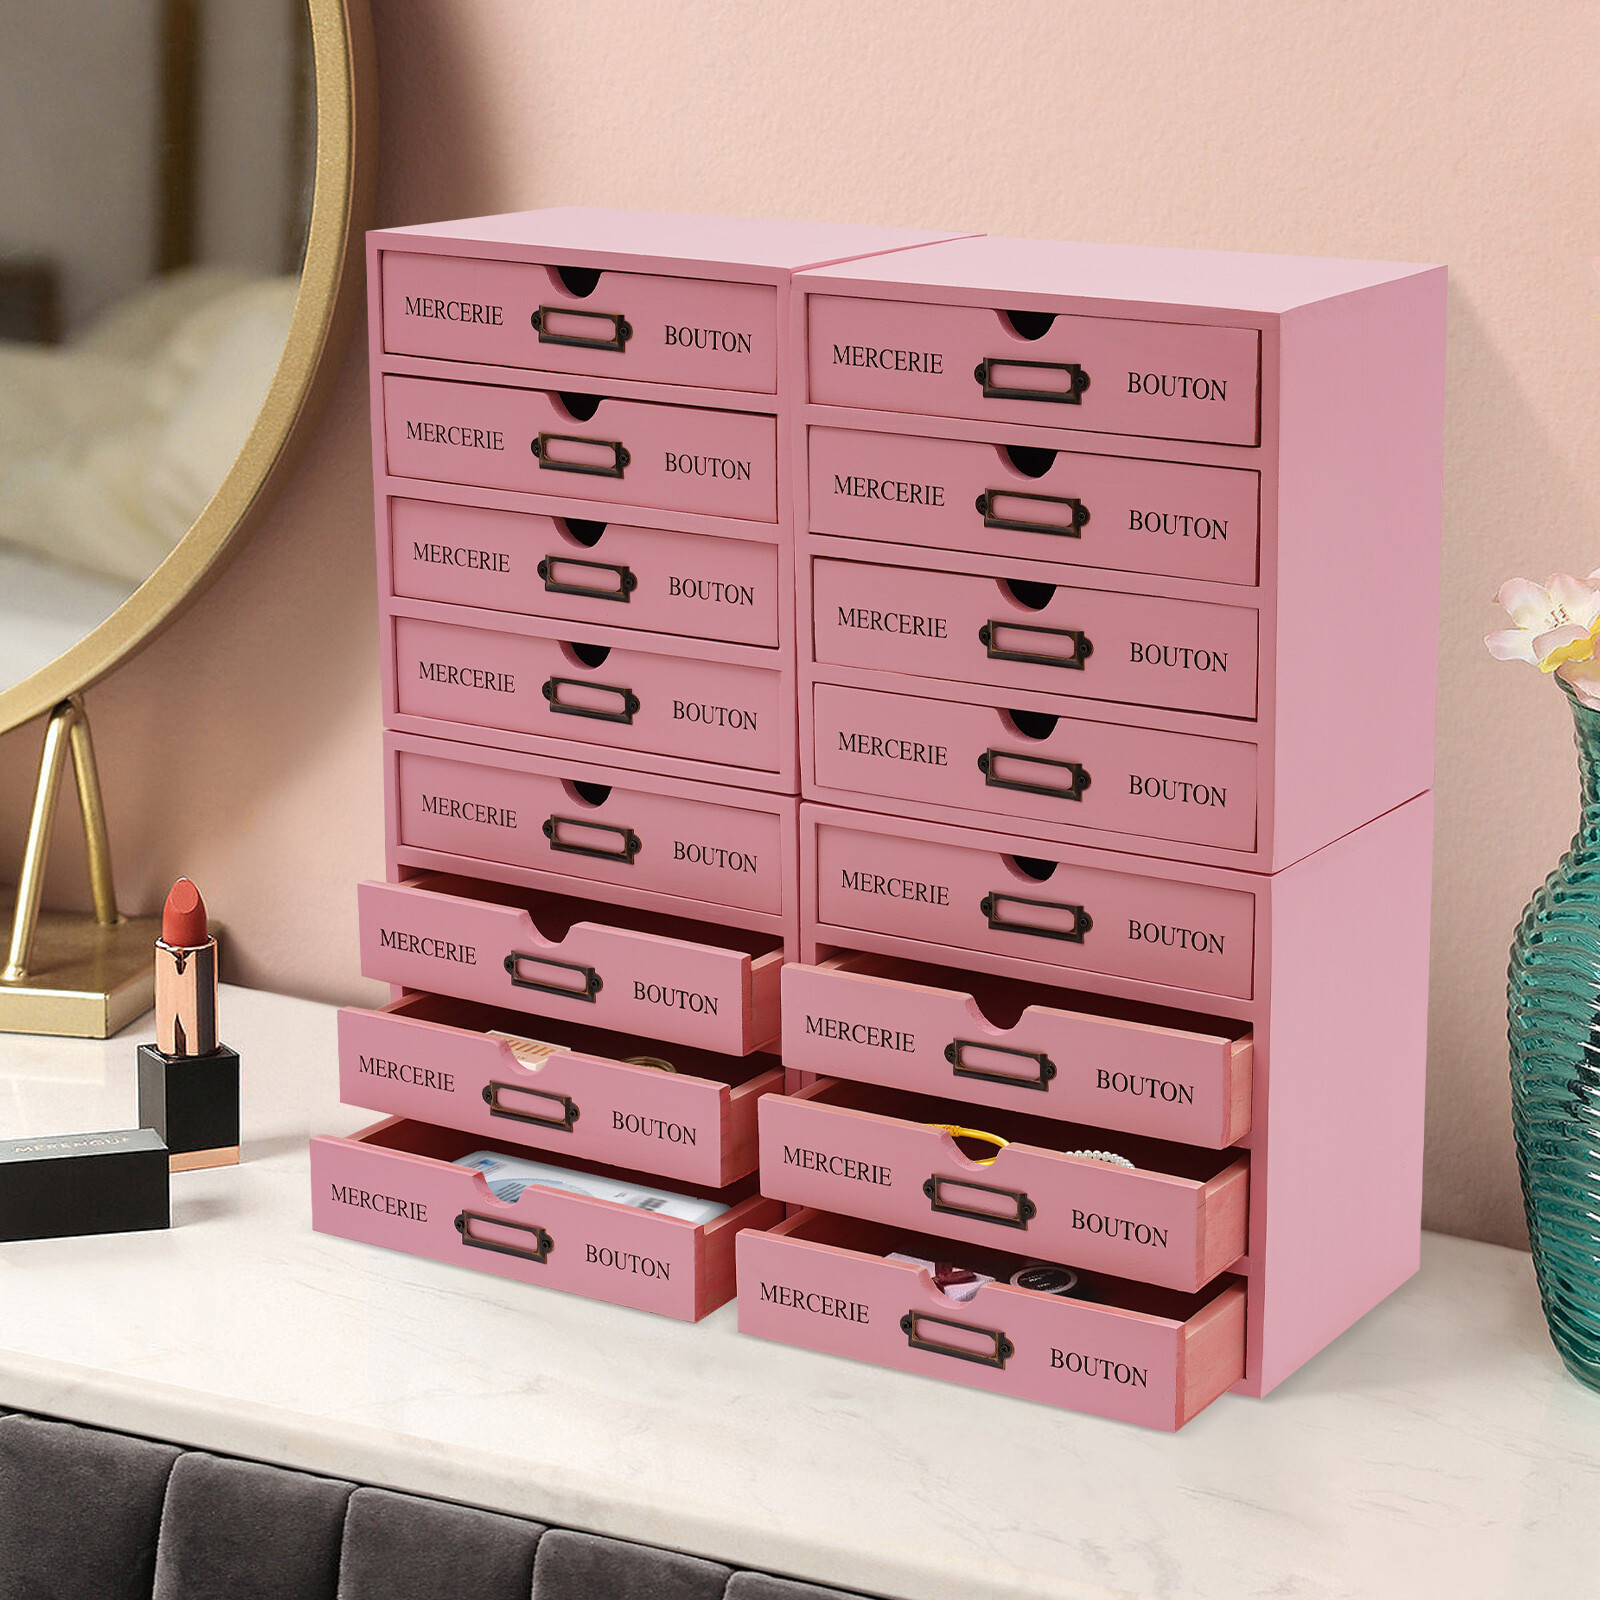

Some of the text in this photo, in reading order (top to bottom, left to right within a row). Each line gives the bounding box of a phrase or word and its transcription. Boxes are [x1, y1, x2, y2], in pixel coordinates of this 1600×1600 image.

[405, 295, 753, 354] MERCERIE BOUTON
[832, 343, 1228, 402] MERCERIE BOUTON
[406, 420, 752, 482] MERCERIE BOUTON
[833, 474, 1229, 542] MERCERIE BOUTON
[413, 541, 755, 607] MERCERIE BOUTON
[837, 606, 1229, 674] MERCERIE BOUTON
[418, 660, 758, 732] MERCERIE BOUTON
[838, 731, 1227, 808] MERCERIE BOUTON
[421, 793, 758, 874] MERCERIE BOUTON
[841, 868, 1226, 956] MERCERIE BOUTON
[379, 928, 719, 1017] MERCERIE BOUTON
[805, 1014, 1195, 1106] MERCERIE BOUTON
[358, 1054, 697, 1147] MERCERIE BOUTON
[331, 1183, 671, 1281] MERCERIE BOUTON
[783, 1144, 1169, 1249] MERCERIE BOUTON
[759, 1281, 1149, 1389] MERCERIE BOUTON
